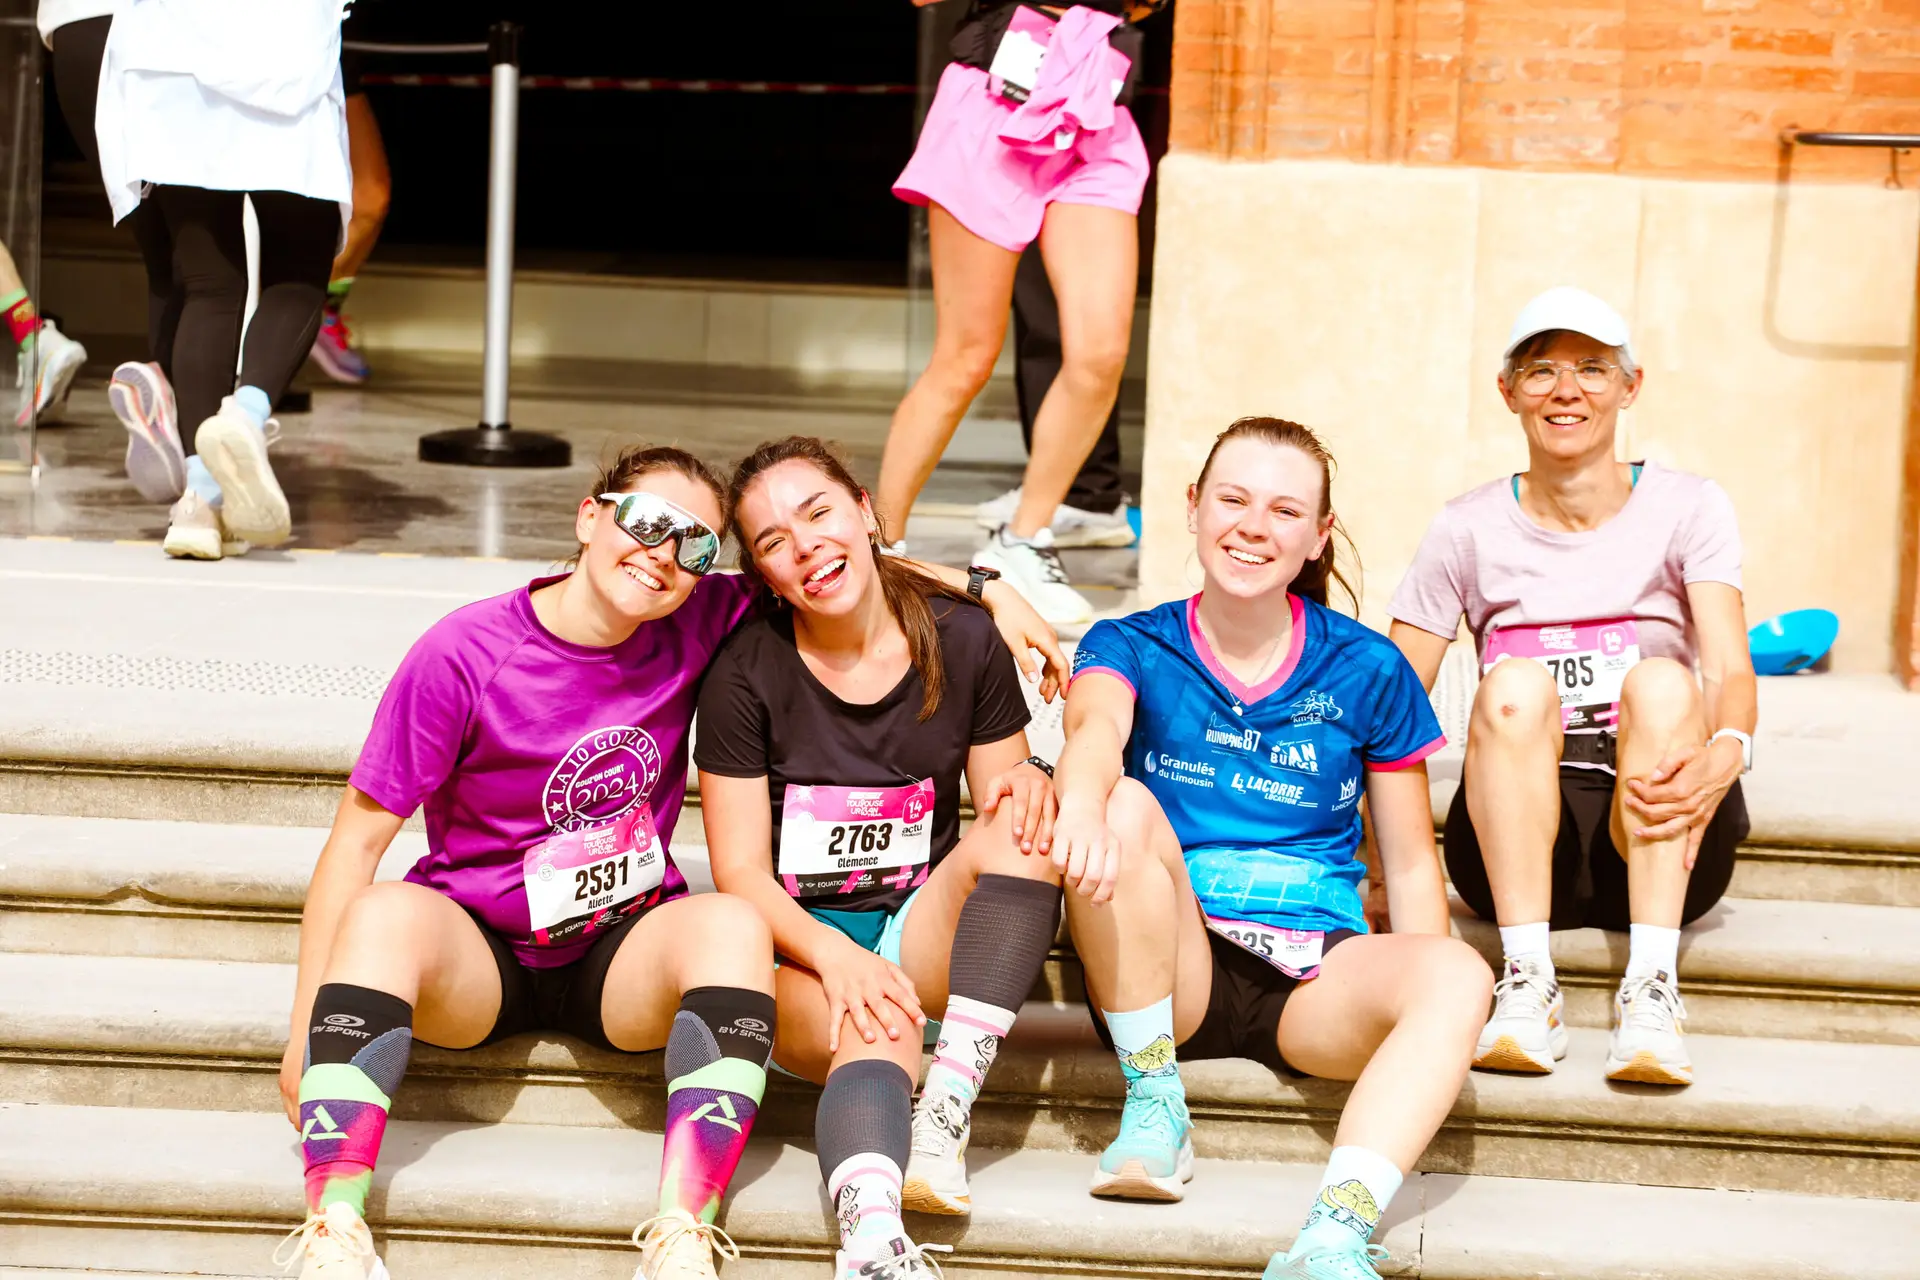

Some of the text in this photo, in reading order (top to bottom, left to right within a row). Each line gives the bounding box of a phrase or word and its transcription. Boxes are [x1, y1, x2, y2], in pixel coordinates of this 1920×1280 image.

[1206, 729, 1261, 752] RUNNING 87
[604, 764, 625, 778] COURT
[1160, 754, 1216, 777] Granulés
[550, 773, 573, 795] LA
[1158, 768, 1214, 788] du Limousin
[576, 771, 639, 810] 2024
[1246, 776, 1304, 800] LACORRE
[908, 800, 923, 814] 14
[1264, 793, 1298, 806] LOCATION
[634, 826, 646, 842] 14
[902, 824, 923, 834] actu
[828, 823, 893, 855] 2763
[638, 851, 655, 864] actu
[838, 855, 878, 868] Clémence
[575, 855, 629, 901] 2531
[818, 880, 848, 888] EQUATION
[588, 894, 614, 910] Aliette
[565, 919, 590, 933] EQUATION
[311, 1025, 371, 1039] BV SPORT
[718, 1026, 771, 1047] BV SPORT
